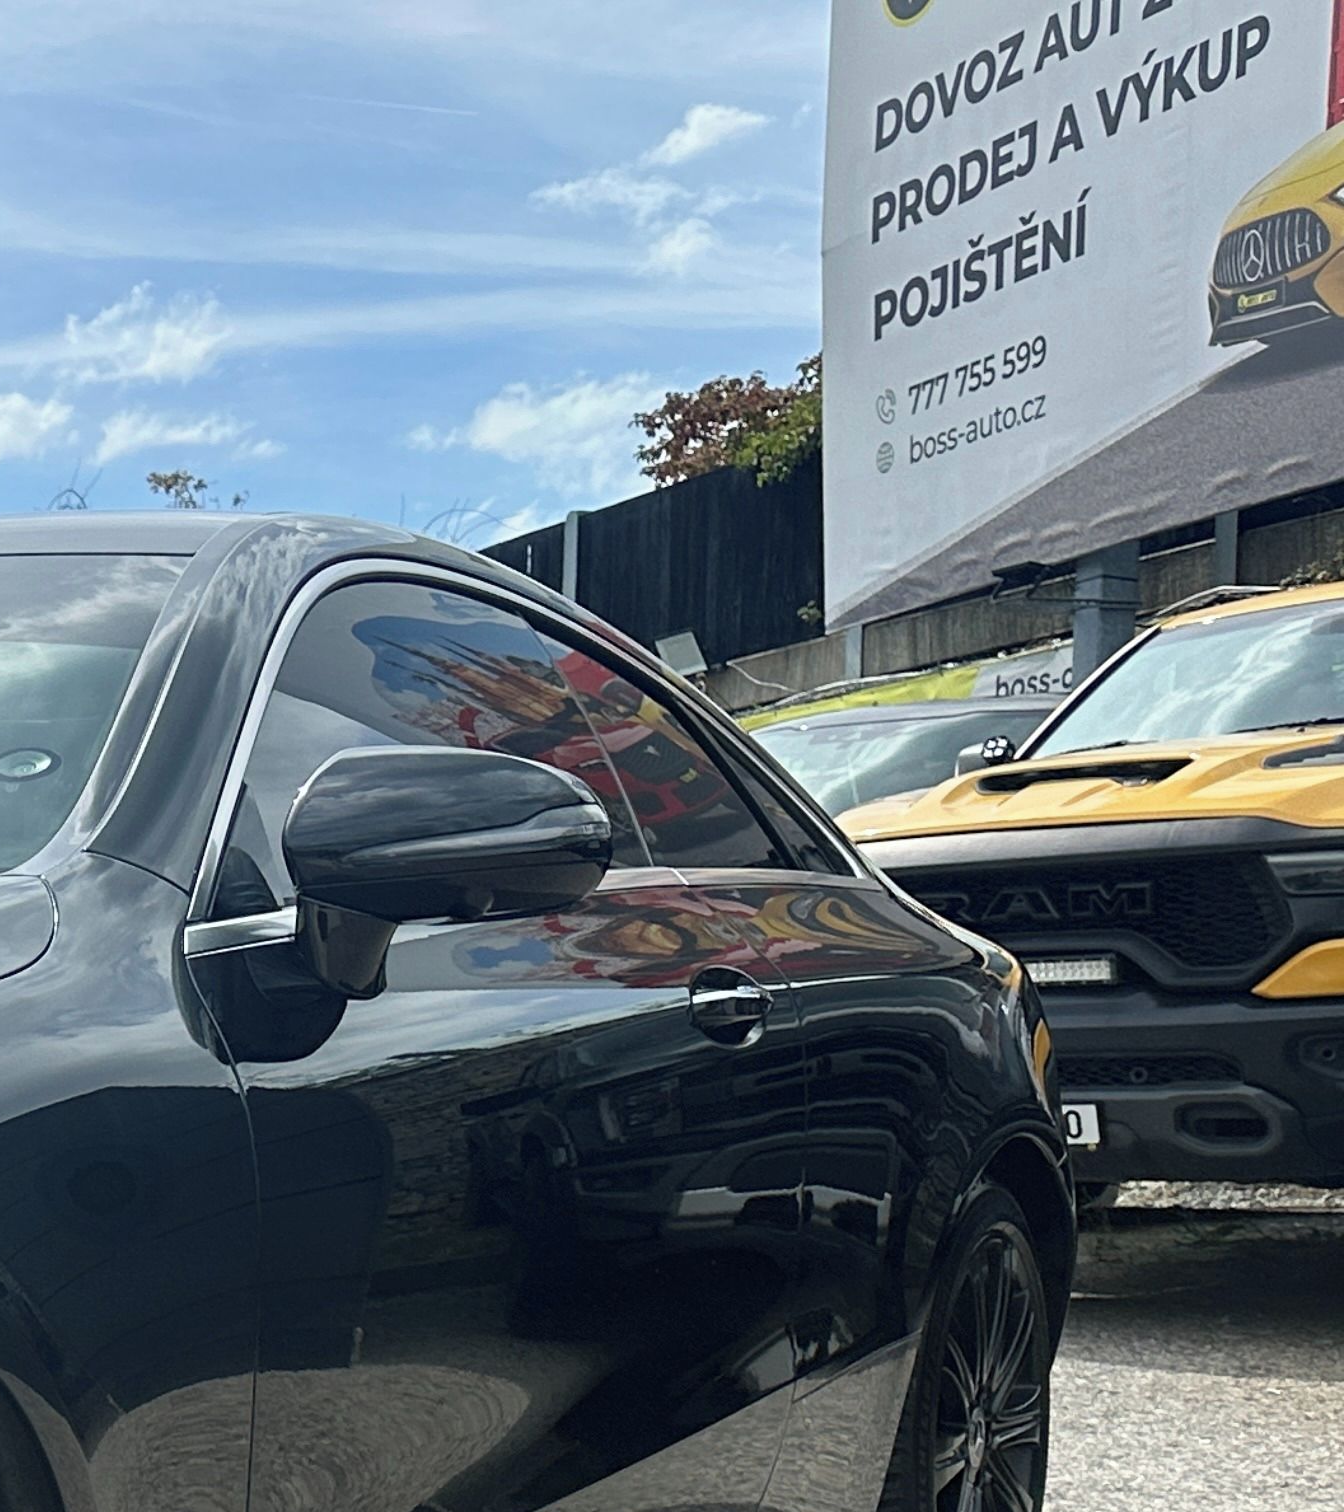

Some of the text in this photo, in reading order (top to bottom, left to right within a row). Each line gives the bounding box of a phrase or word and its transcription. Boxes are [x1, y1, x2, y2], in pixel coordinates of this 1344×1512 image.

[871, 15, 1271, 245] PRODEJ A VÝKUP
[874, 30, 1025, 153] DOVOZ
[873, 186, 1092, 341] POJIŠTĚNÍ
[908, 335, 1048, 416] 777 755 599
[909, 393, 1047, 464] boss-auto.cz
